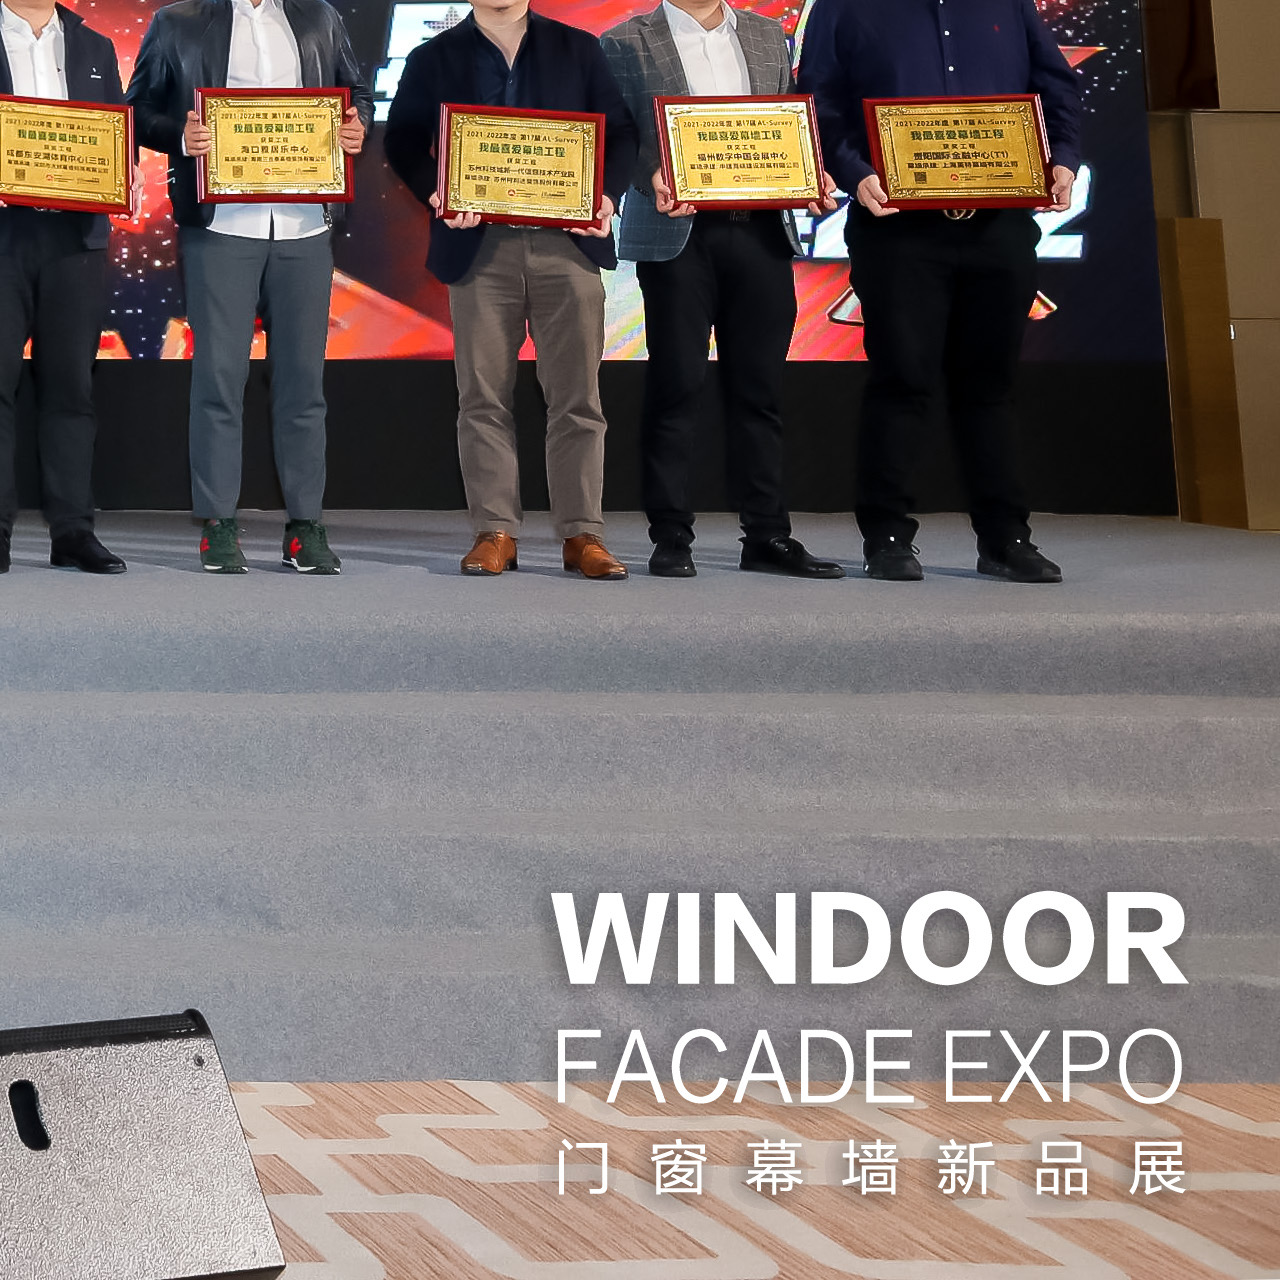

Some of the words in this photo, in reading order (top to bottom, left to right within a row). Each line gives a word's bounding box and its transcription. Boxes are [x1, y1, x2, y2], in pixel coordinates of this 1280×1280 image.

[234, 123, 314, 133] 我最喜爱幕墙工程
[18, 129, 98, 145] 我最喜爱幕墙工程
[698, 130, 782, 141] 我最喜爱幕墙工程
[910, 129, 1004, 140] 我最喜爱幕墙工程
[479, 143, 565, 157] 我最喜爱幕墙工程
